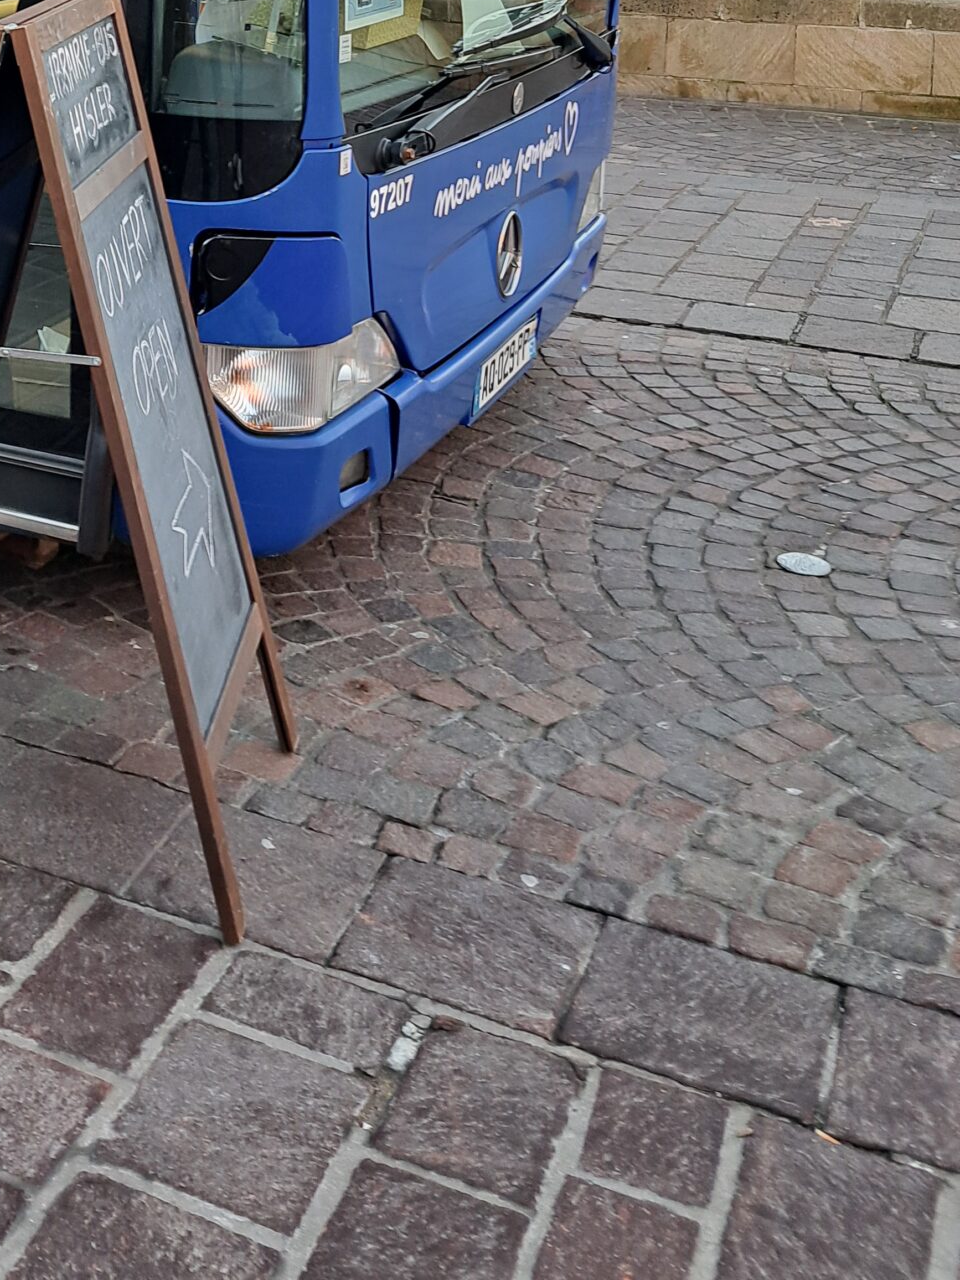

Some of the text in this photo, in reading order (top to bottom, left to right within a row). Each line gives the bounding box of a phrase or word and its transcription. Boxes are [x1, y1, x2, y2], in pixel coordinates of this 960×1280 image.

[68, 83, 117, 156] HISLER
[369, 173, 414, 219] 97207
[434, 161, 481, 217] merci
[485, 158, 513, 190] aux
[96, 194, 154, 318] OUVERT
[132, 317, 179, 416] OPEN
